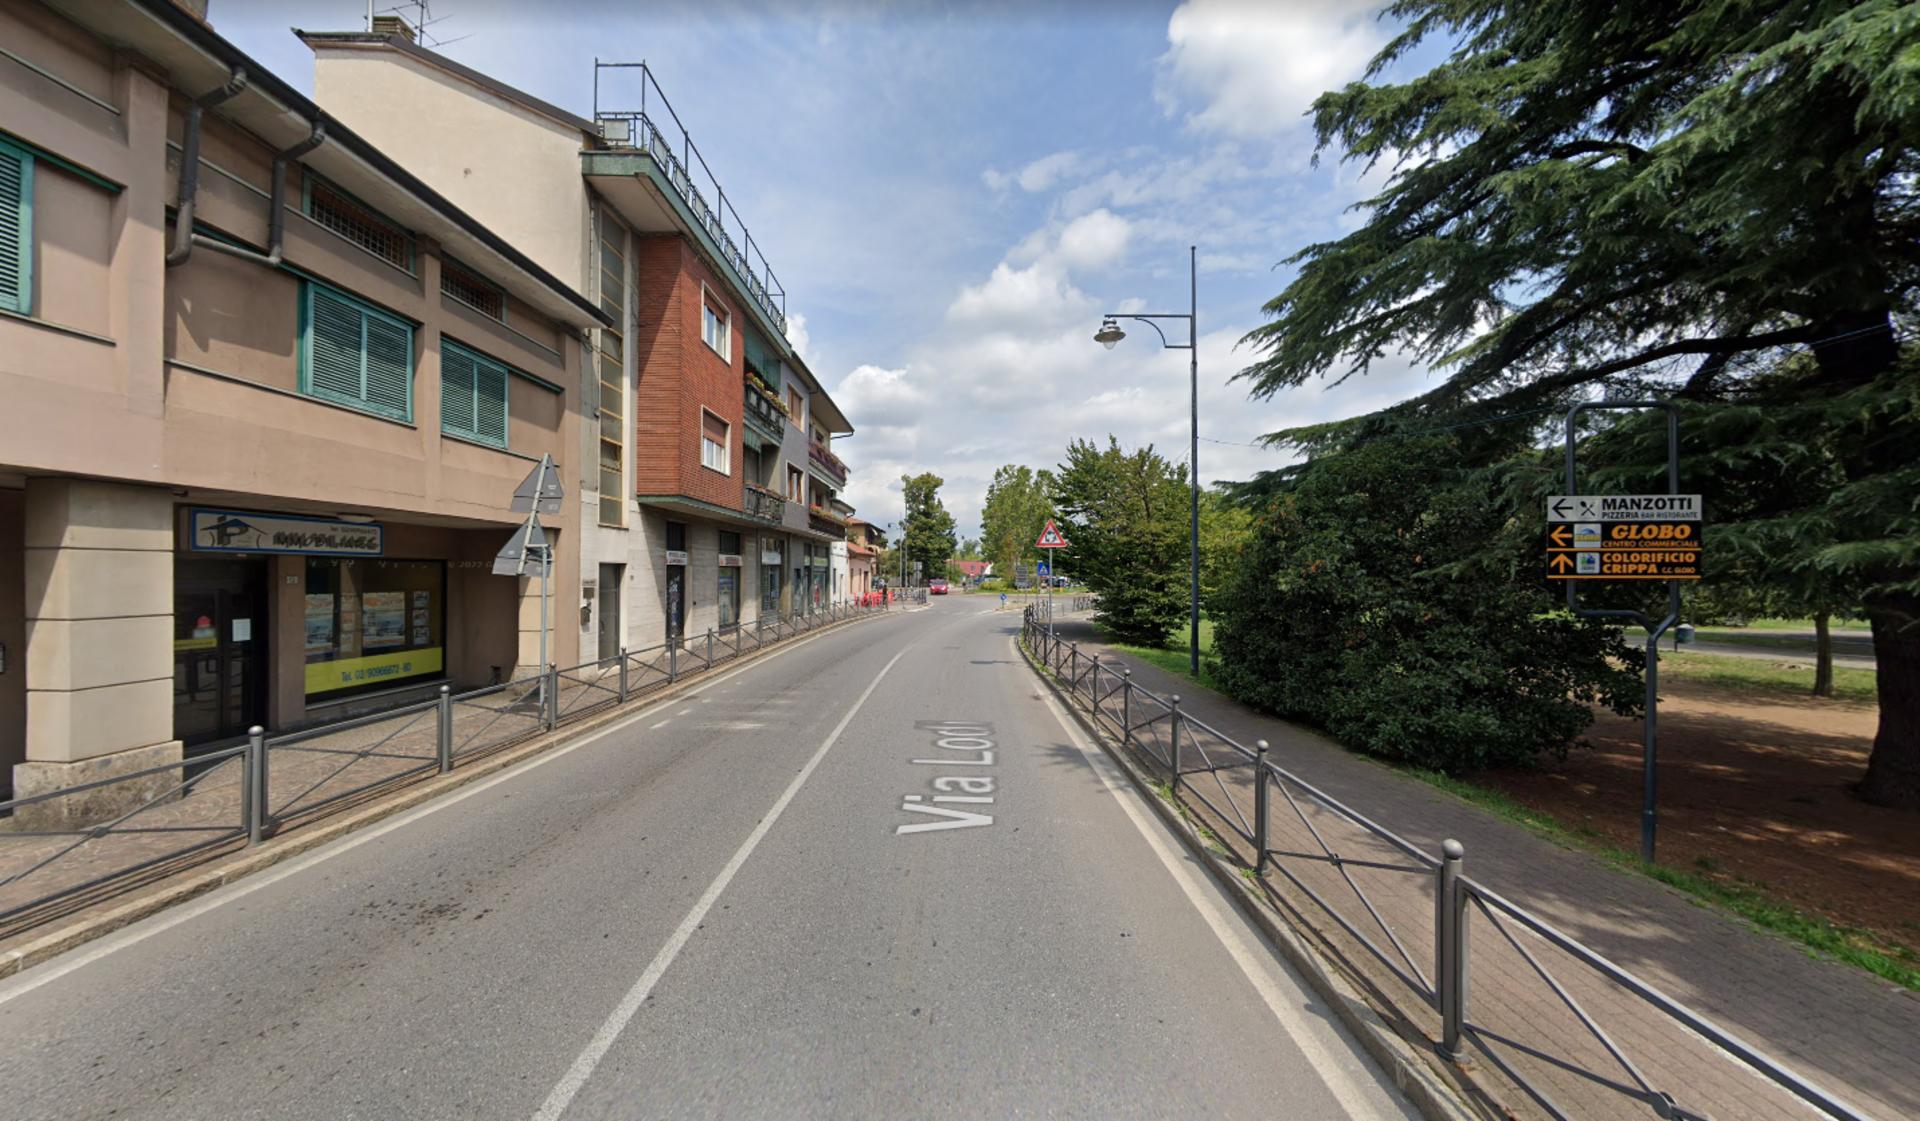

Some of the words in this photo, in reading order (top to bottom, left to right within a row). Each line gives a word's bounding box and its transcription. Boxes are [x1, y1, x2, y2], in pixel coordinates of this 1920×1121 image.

[1602, 498, 1692, 510] MANZOTTI
[1611, 524, 1691, 539] GLOBO
[1602, 540, 1637, 548] CENTRO
[1638, 540, 1698, 548] COMMERCIALE
[1602, 553, 1696, 563] COLORIFICIO
[1602, 564, 1658, 574] CRIPPA
